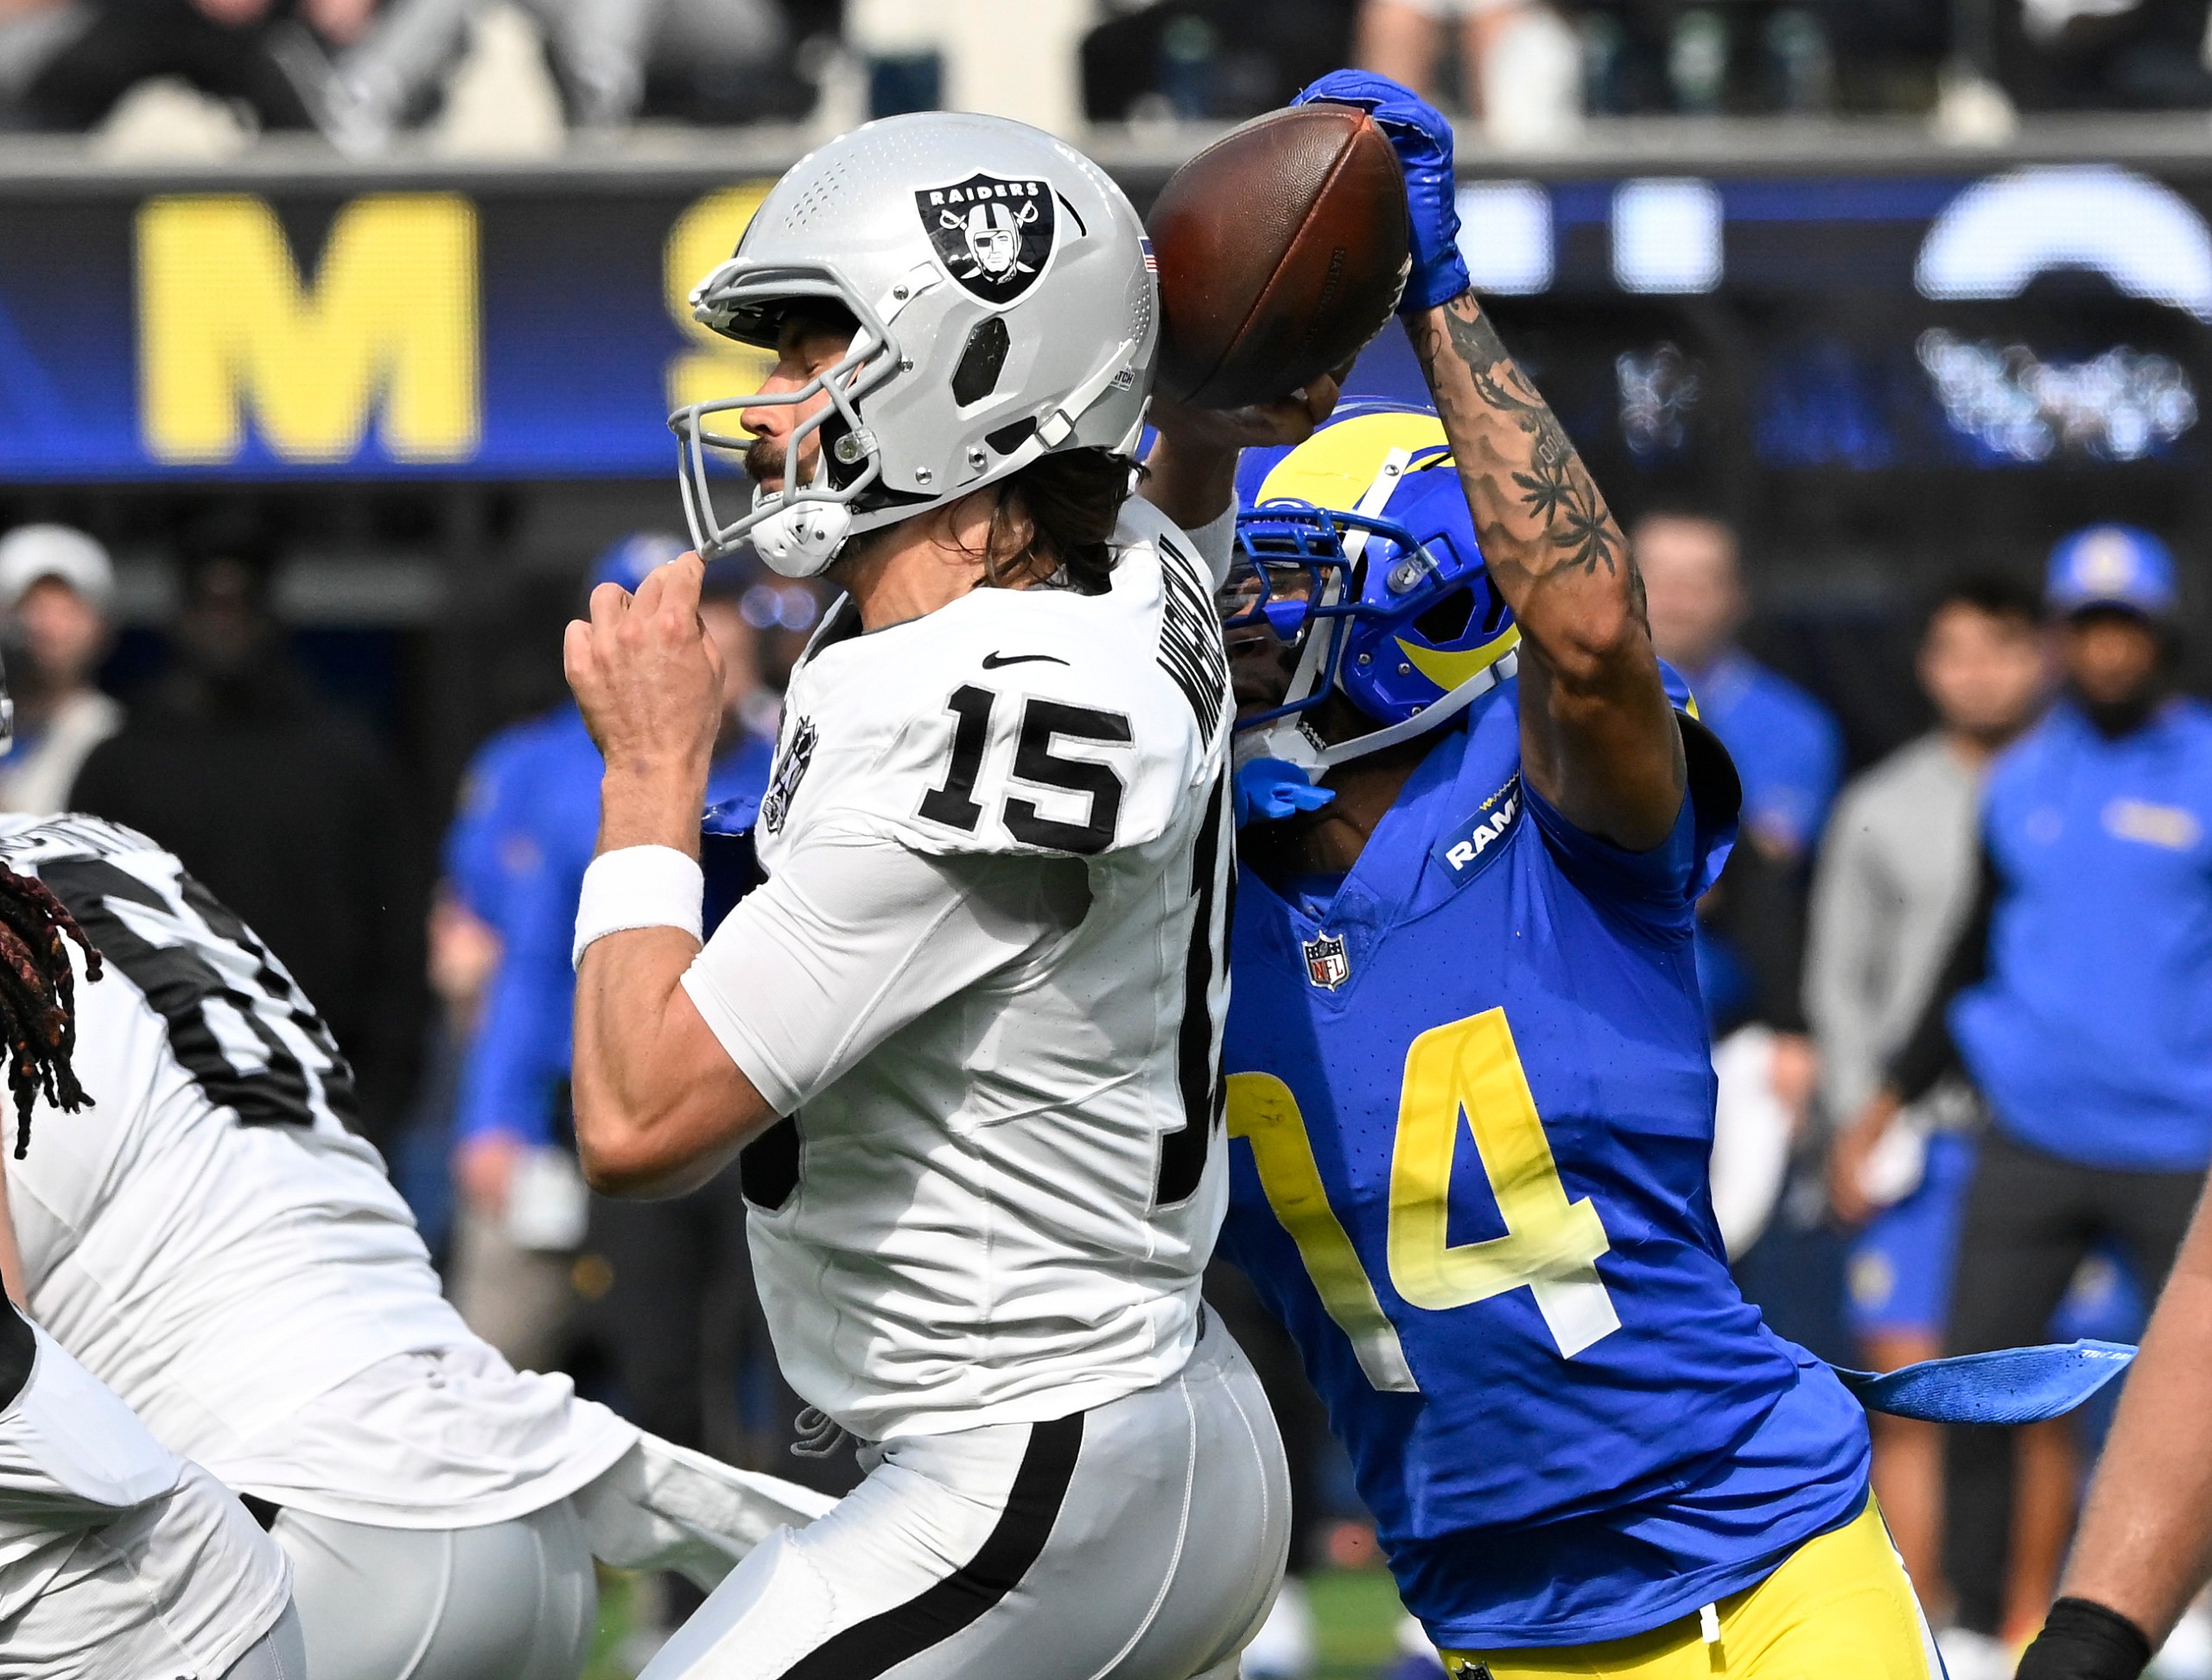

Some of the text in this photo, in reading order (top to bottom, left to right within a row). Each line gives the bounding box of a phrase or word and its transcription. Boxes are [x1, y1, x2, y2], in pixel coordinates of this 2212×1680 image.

[929, 182, 1039, 206] RAIDERS
[914, 683, 1134, 854] 15
[1313, 958, 1344, 980] NFL
[1225, 1006, 1621, 1394] 14
